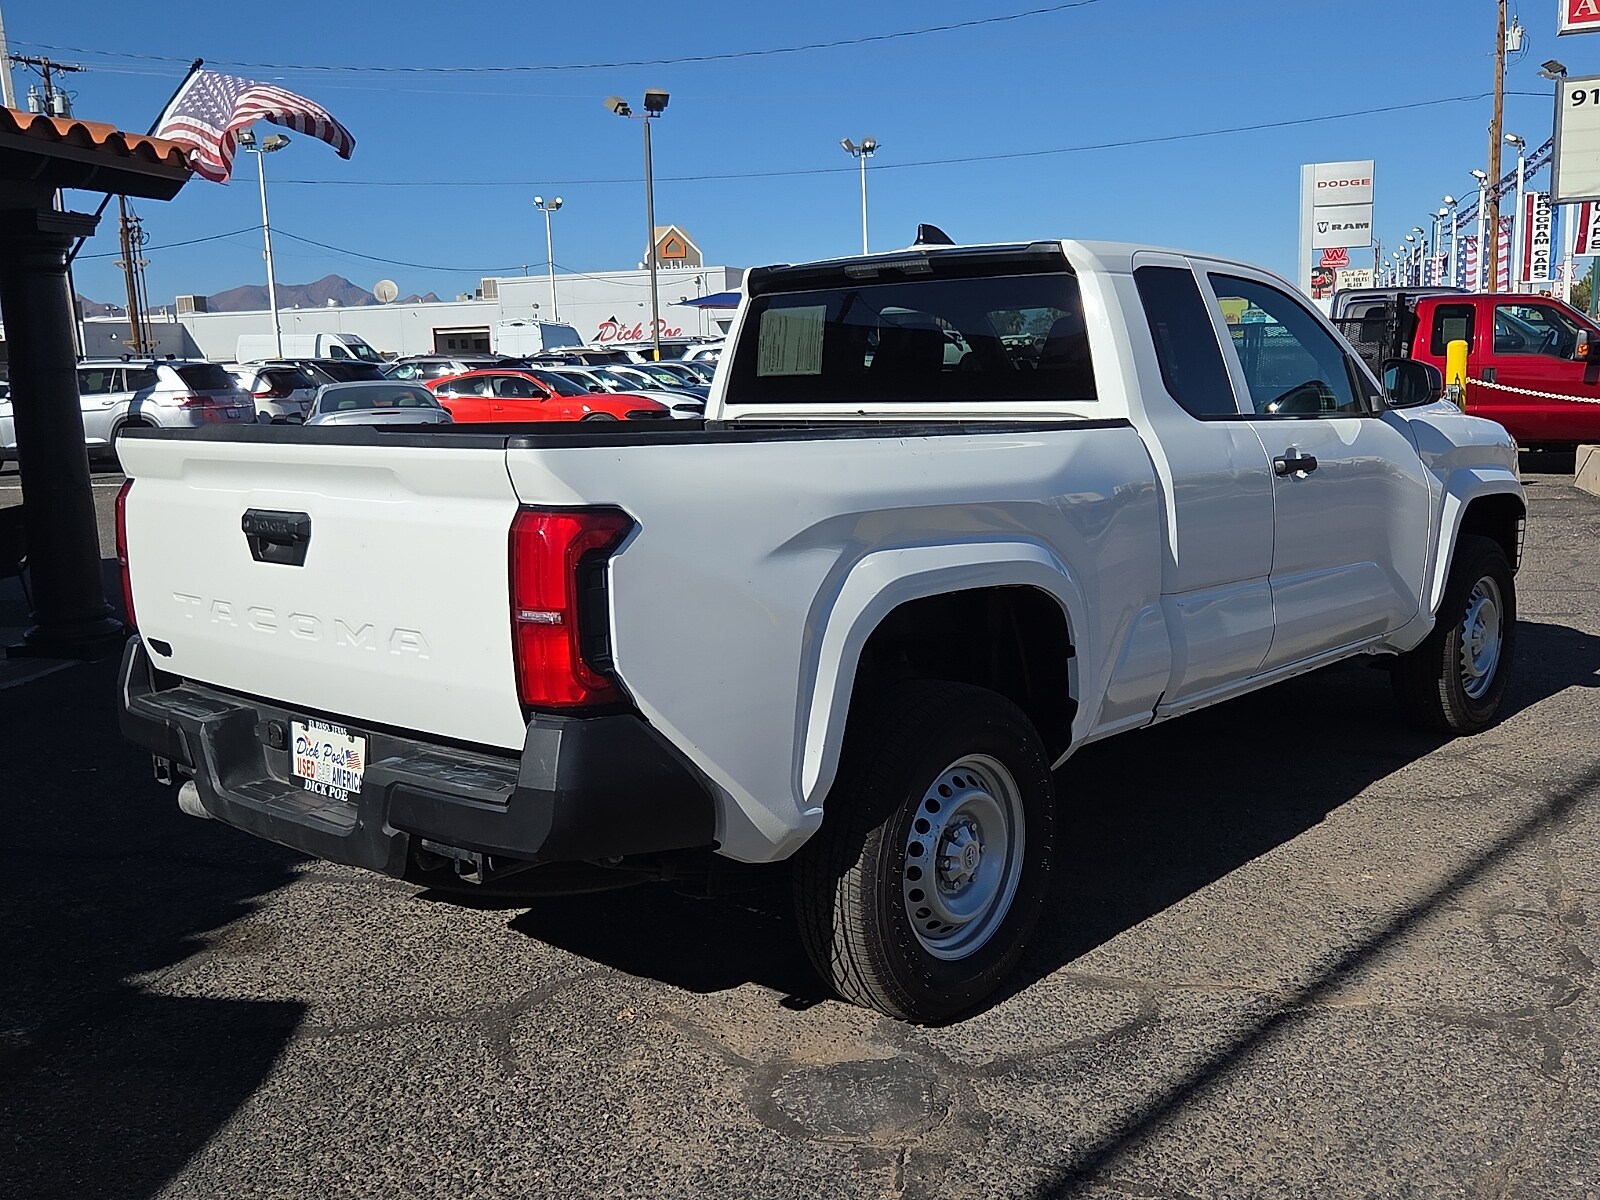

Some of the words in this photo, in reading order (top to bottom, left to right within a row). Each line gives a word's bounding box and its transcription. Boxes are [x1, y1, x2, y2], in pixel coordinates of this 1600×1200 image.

[1317, 178, 1371, 189] DODGE
[1331, 222, 1369, 231] RAM
[1534, 193, 1550, 245] PROGRAM
[1533, 249, 1548, 279] CARS
[598, 321, 643, 342] Dick
[650, 318, 683, 339] Poe
[172, 591, 430, 660] TACOMA
[296, 736, 320, 760] Dick
[297, 757, 316, 779] USED
[304, 778, 328, 796] DICK
[328, 785, 349, 802] POE
